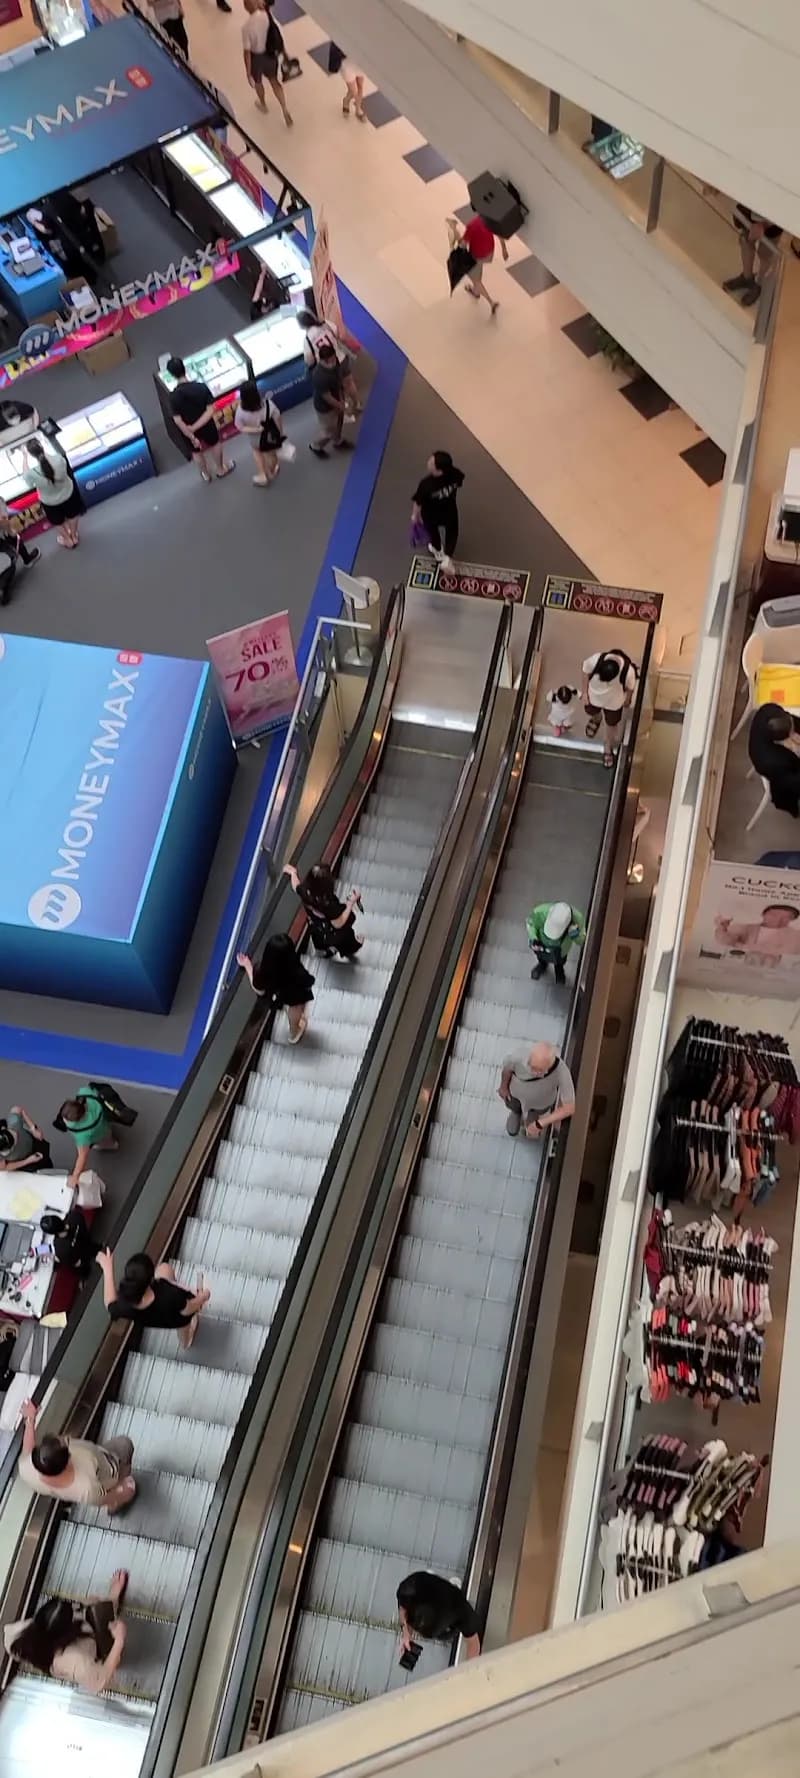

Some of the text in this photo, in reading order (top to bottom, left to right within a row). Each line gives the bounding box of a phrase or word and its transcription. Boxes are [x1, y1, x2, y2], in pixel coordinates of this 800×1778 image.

[55, 243, 216, 337] MONEYMAX
[241, 639, 281, 662] SALE
[51, 668, 139, 880] MONEYMAX
